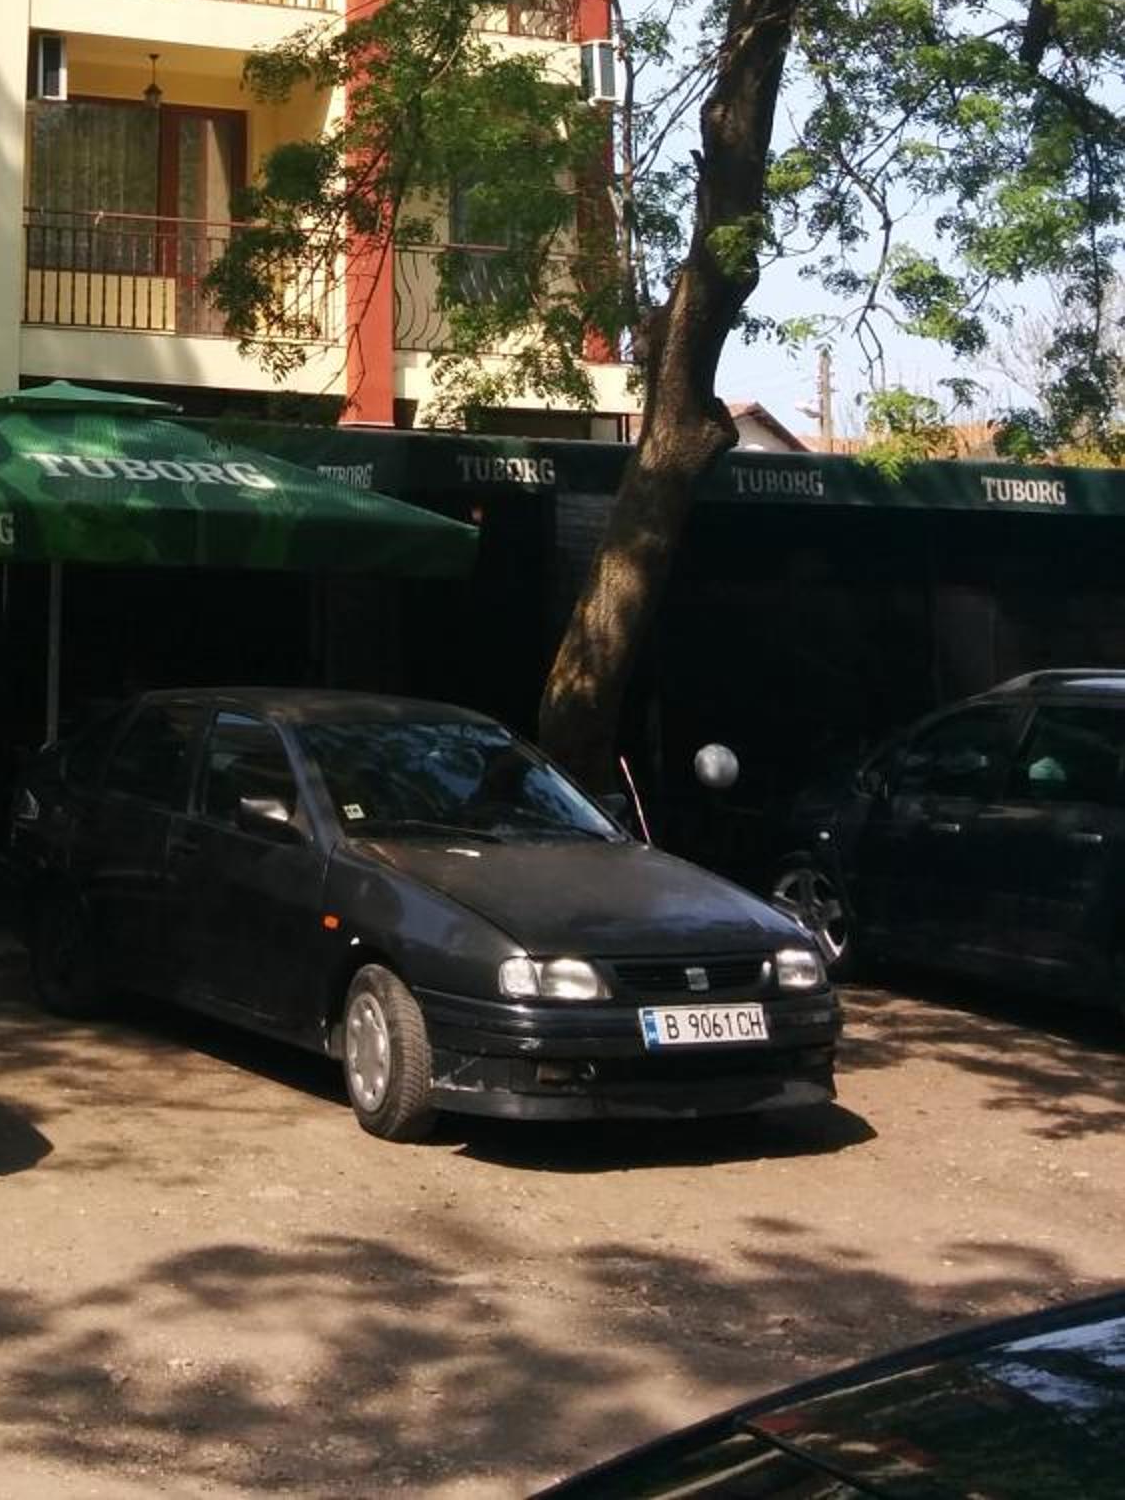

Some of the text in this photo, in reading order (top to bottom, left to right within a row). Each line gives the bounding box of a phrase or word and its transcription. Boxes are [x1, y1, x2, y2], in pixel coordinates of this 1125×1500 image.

[22, 451, 277, 490] TUBORG
[457, 454, 556, 485] TUBORG
[732, 466, 825, 497] TUBORG
[980, 475, 1066, 507] TUBORG
